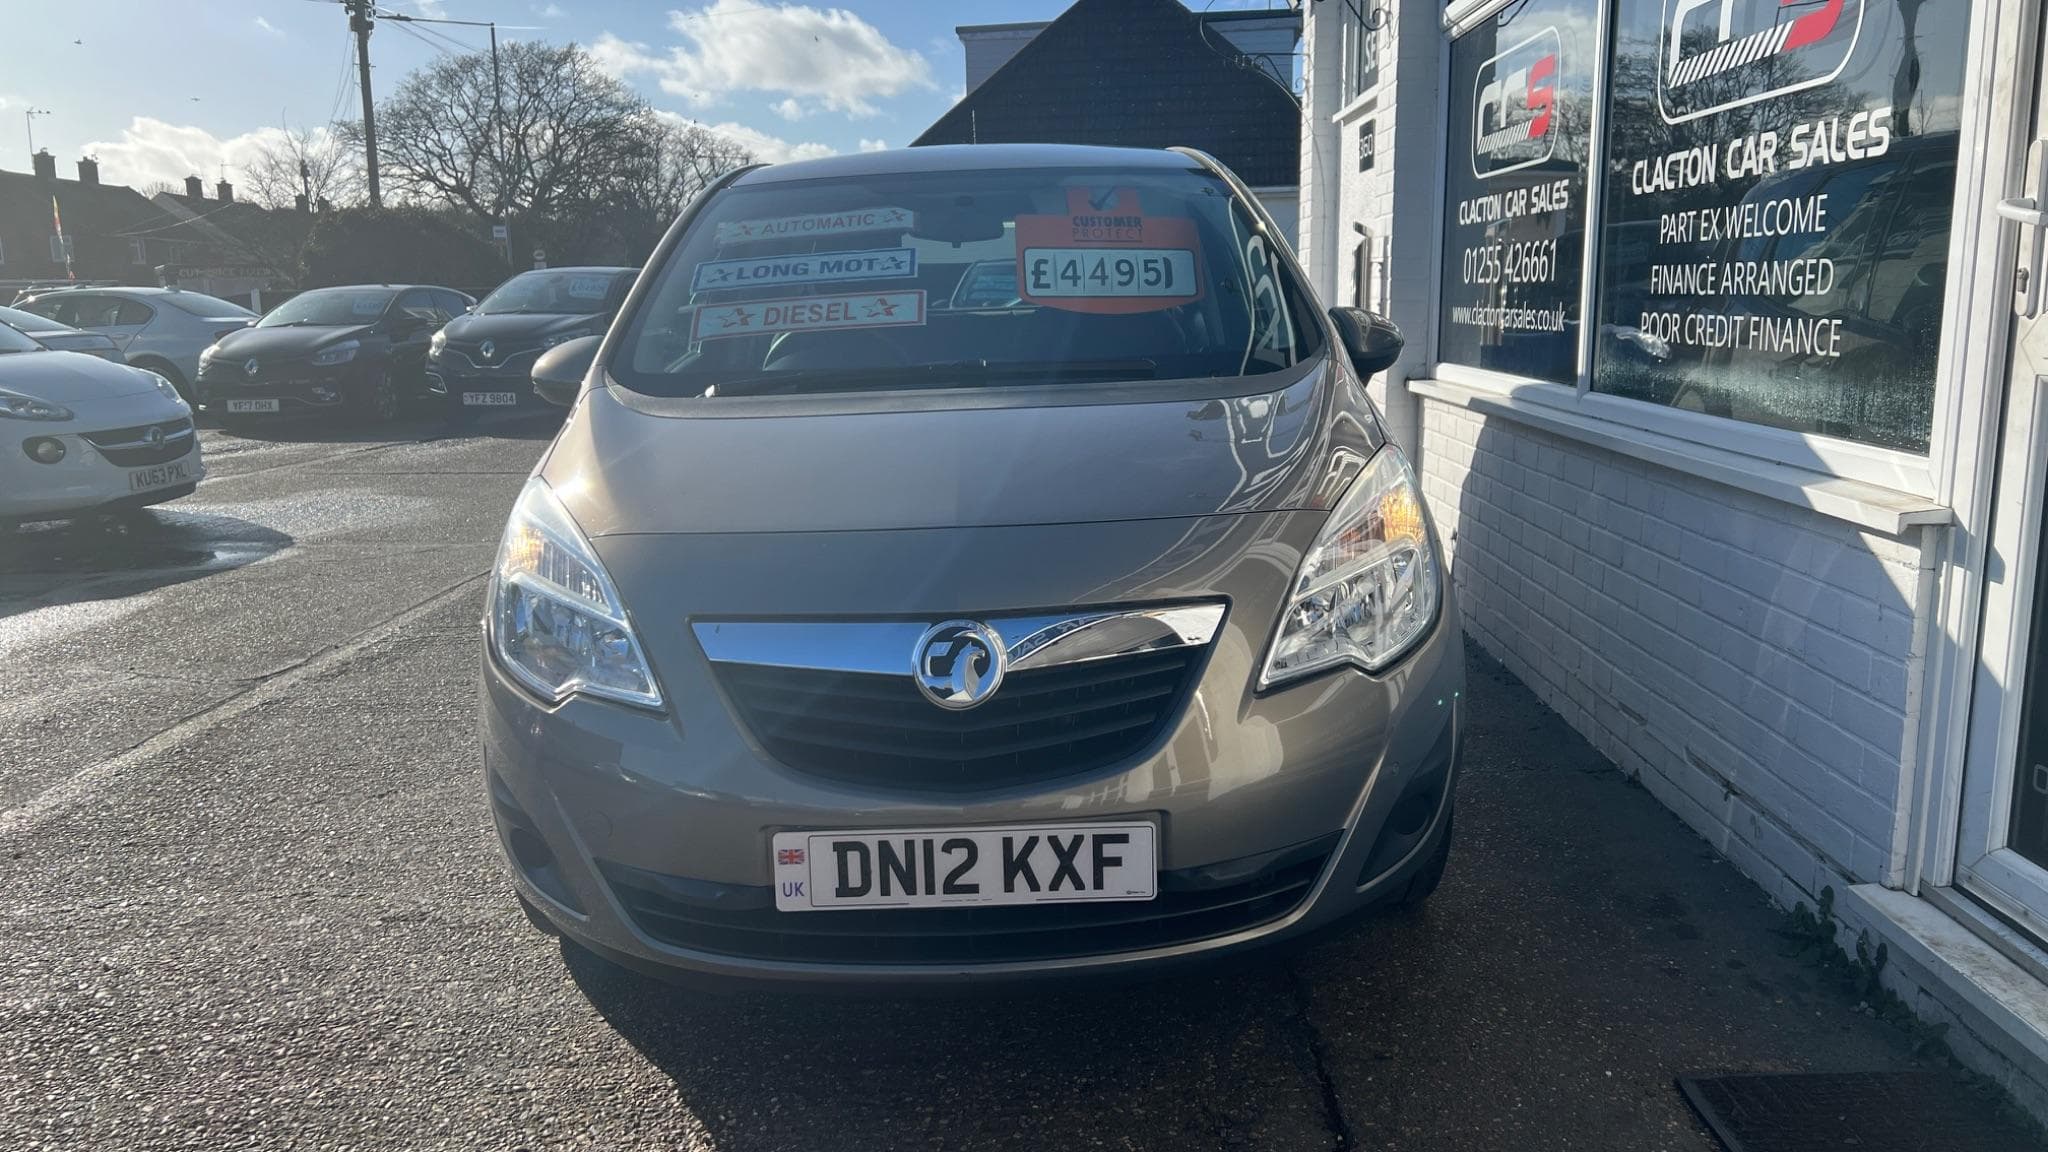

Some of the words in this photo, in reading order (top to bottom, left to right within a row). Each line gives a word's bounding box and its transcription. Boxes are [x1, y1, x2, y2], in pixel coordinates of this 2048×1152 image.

[1632, 143, 1718, 195] CLACTON
[1726, 131, 1778, 180] CAR
[1788, 106, 1891, 170] SALES
[1459, 193, 1502, 225] CLACTON
[1504, 188, 1528, 218] CAR
[1531, 178, 1569, 215] SALES
[760, 212, 875, 235] AUTOMATIC
[1072, 216, 1144, 228] CUSTOMER
[1072, 227, 1143, 239] PROTECT
[1660, 210, 1697, 244] PART
[1700, 207, 1721, 242] EX
[1724, 194, 1828, 240] WELCOME
[736, 262, 810, 281] LONG
[819, 257, 881, 274] MOT
[1463, 245, 1502, 285] 01255
[1503, 238, 1557, 283] 426661
[1650, 262, 1717, 296] FINANCE
[1720, 258, 1834, 296] ARRANGED
[763, 302, 857, 326] DIESEL
[1640, 311, 1681, 345] POOR
[1685, 313, 1745, 349] CREDIT
[1749, 315, 1843, 358] FINANCE
[135, 467, 166, 488] KU63
[166, 463, 187, 483] PXL
[832, 837, 980, 898] DN12
[1002, 833, 1130, 893] KXF
[782, 881, 805, 898] UK
